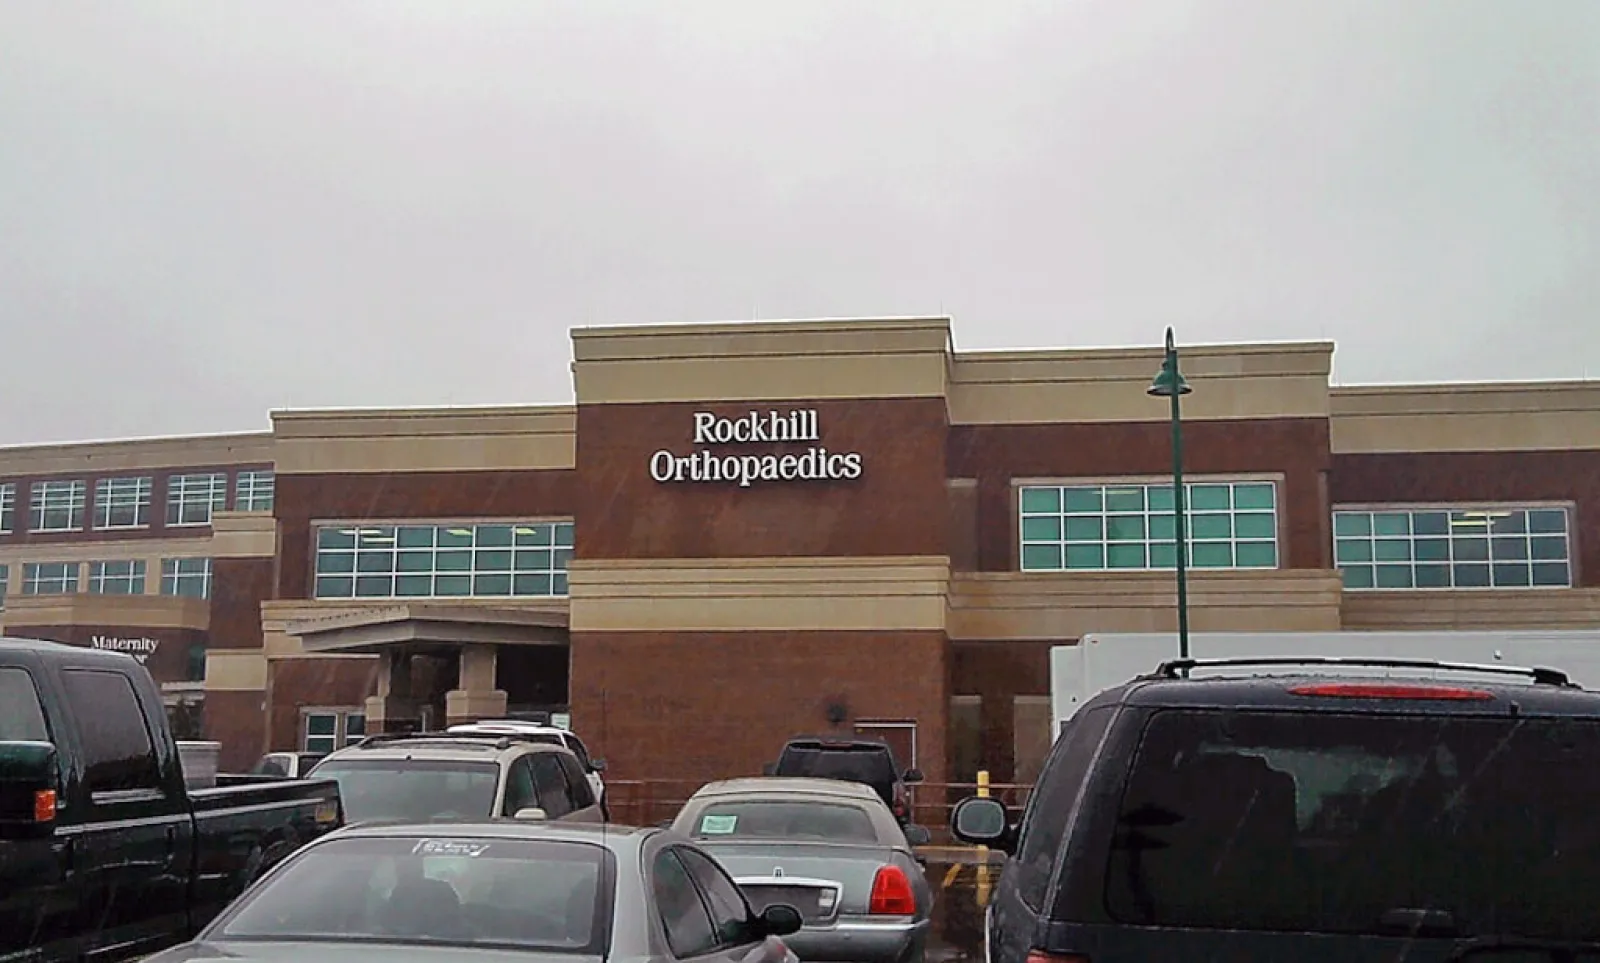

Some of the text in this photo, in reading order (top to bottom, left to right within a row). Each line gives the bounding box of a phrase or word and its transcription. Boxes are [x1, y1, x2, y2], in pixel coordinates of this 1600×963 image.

[693, 410, 819, 443] Rockhill
[650, 448, 862, 487] Orthopaedics
[91, 635, 159, 654] Maternity
